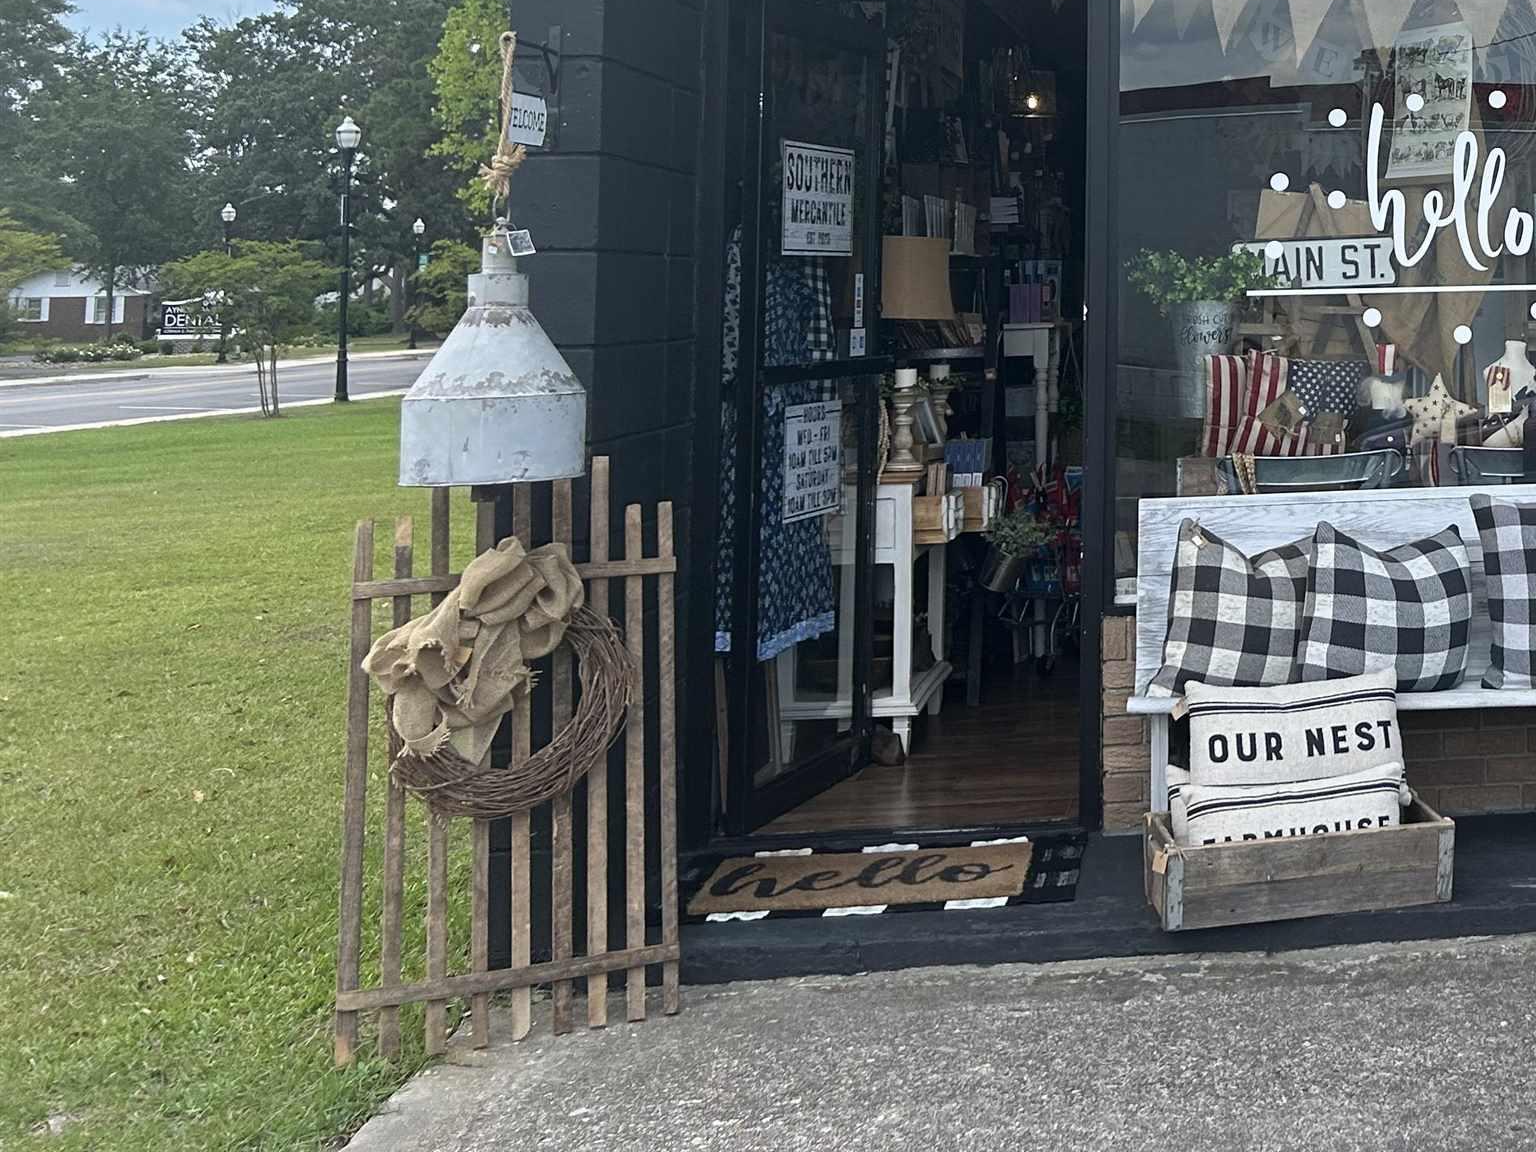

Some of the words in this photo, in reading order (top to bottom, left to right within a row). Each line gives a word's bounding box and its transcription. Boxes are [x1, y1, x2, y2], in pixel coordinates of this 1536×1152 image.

[511, 107, 545, 132] ELCOME
[787, 153, 851, 194] SOUTHERN
[1367, 102, 1534, 271] hello
[791, 199, 846, 226] MERCANTILE
[1258, 246, 1324, 282] AIN
[1341, 244, 1384, 280] ST.
[1208, 732, 1283, 763] OUR
[1305, 720, 1392, 757] NEST
[710, 854, 1014, 898] hello
